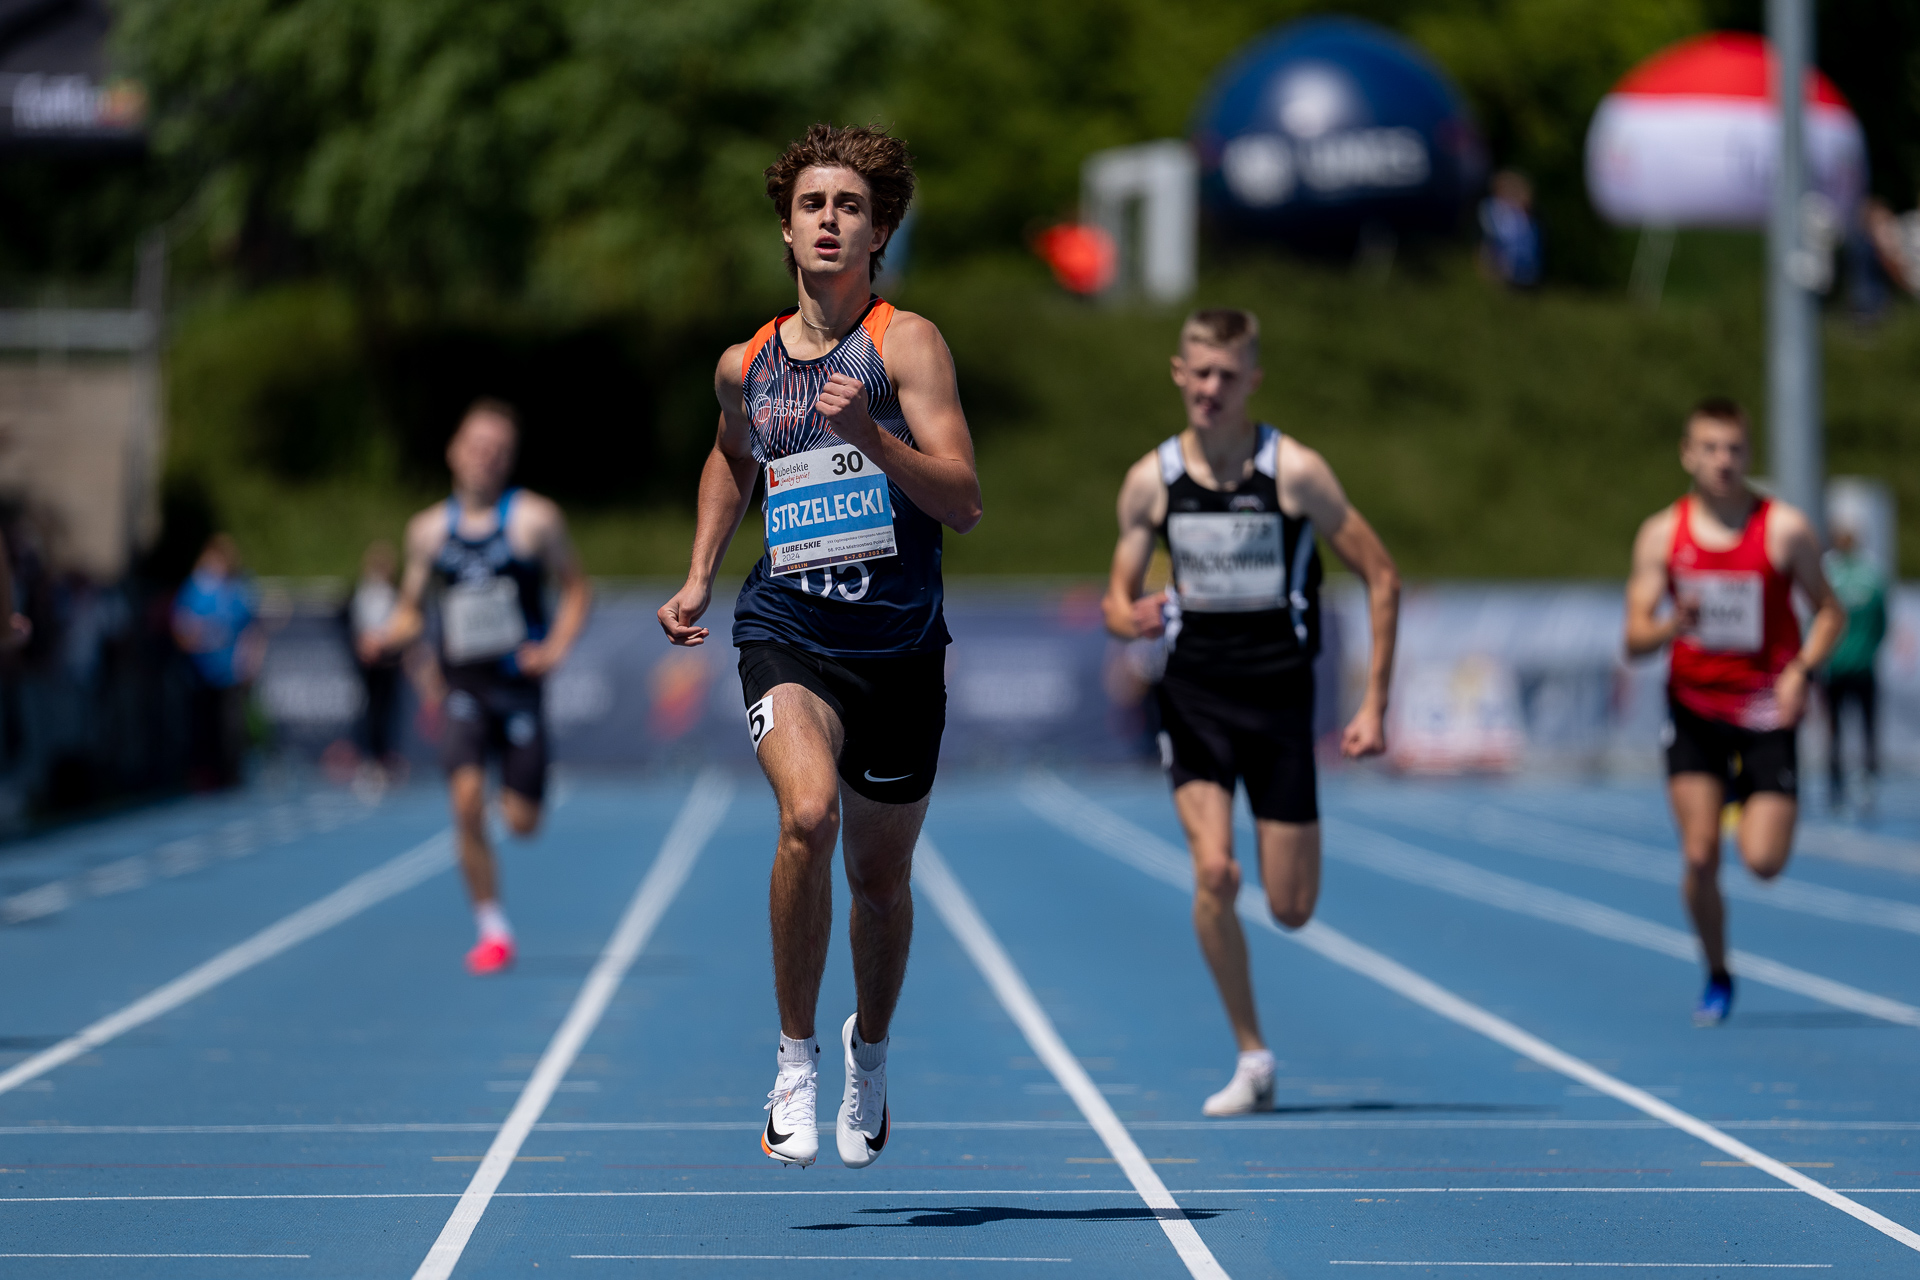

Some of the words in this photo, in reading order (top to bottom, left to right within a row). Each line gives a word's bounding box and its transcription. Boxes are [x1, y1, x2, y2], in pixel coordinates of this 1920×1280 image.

[831, 450, 863, 475] 30
[771, 487, 884, 533] STRZELECKI
[782, 540, 821, 553] LUBELSKIE
[782, 553, 800, 562] 2024
[749, 702, 765, 742] 5
